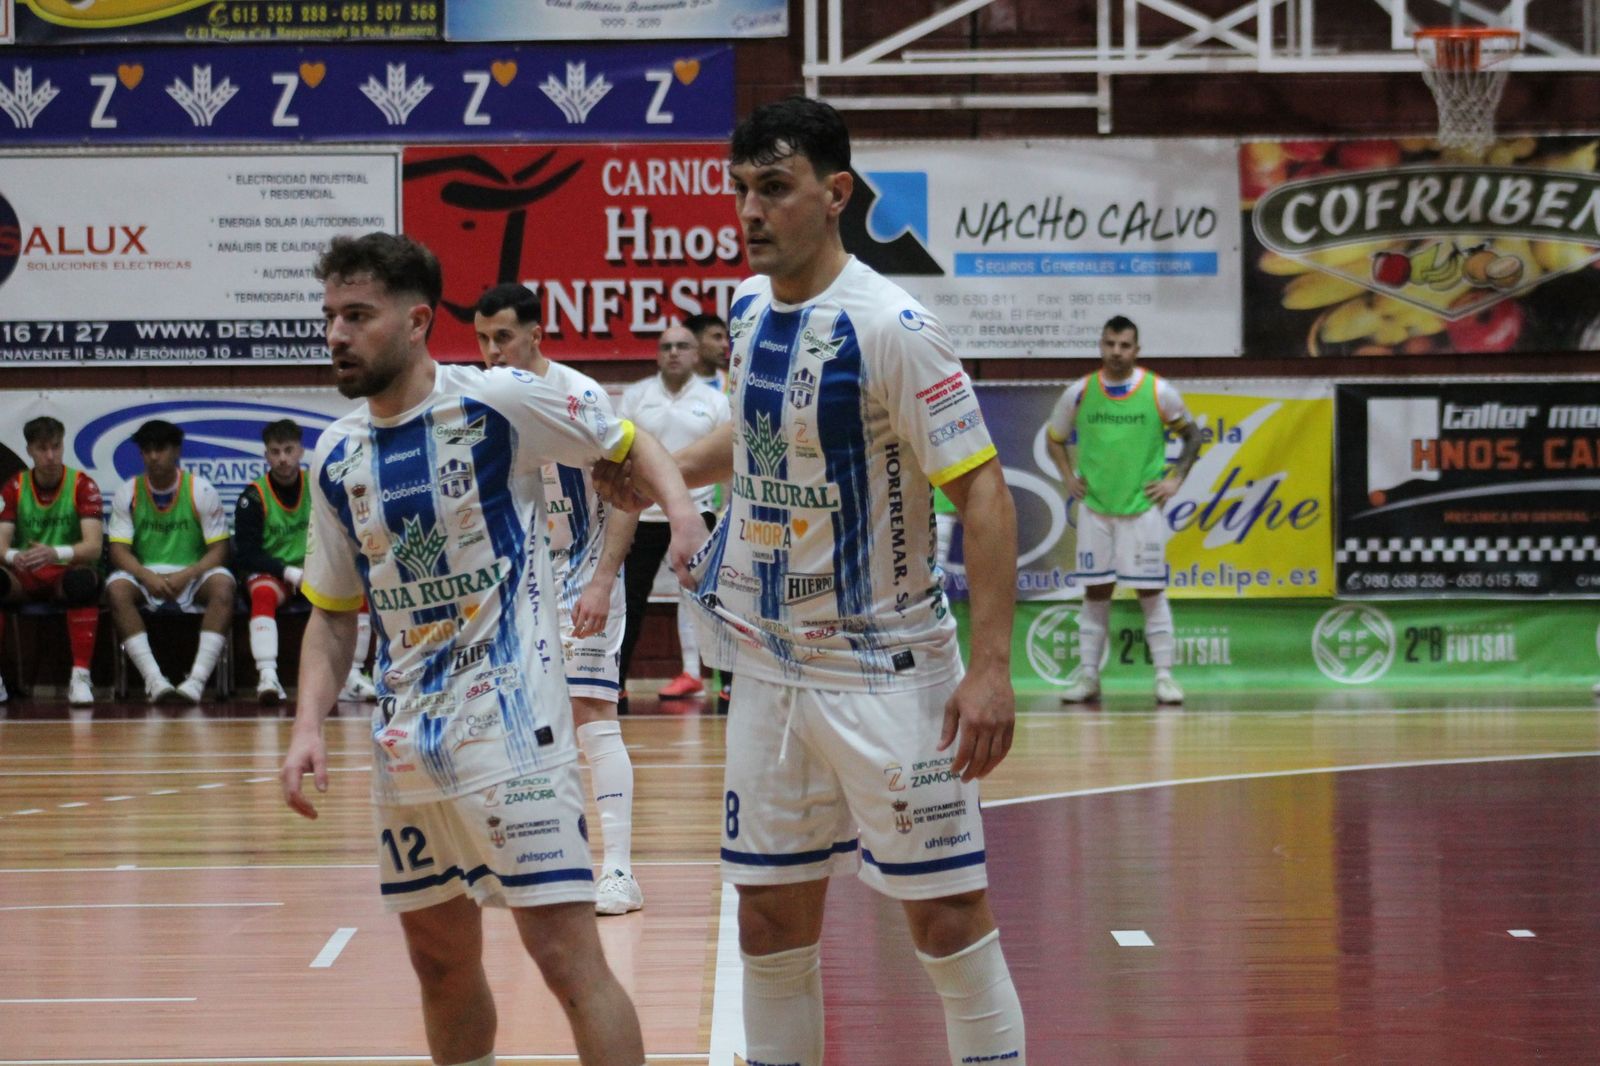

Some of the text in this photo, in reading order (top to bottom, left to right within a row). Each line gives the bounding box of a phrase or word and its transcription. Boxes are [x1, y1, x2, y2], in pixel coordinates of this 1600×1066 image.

[231, 5, 258, 23] 615
[236, 173, 369, 185] ELECTRICIDAD INDUSTRIAL
[260, 189, 335, 200] Y RESIDENCIAL
[264, 216, 298, 228] SOLAR
[956, 195, 1218, 246] NACHO CALVO
[604, 206, 739, 261] Hnos
[265, 242, 278, 252] DE
[27, 260, 192, 272] SOLUCIONES ELECTRICAS
[521, 279, 742, 334] NFEST
[3, 323, 32, 343] 16
[36, 323, 65, 343] 71
[75, 323, 109, 343] 27
[978, 325, 1060, 336] BENAVENTE
[0, 349, 71, 361] NAVENTE
[95, 348, 127, 360] SAN
[212, 347, 231, 360] 10
[1086, 412, 1146, 426] uhlsport
[1443, 402, 1539, 430] taller
[1543, 438, 1600, 470] CA
[761, 480, 839, 509] RURAL
[1165, 466, 1320, 545] elipe
[419, 562, 508, 606] RURAL
[1363, 573, 1389, 588] 980
[1456, 573, 1482, 588] 630
[1172, 636, 1232, 666] UTSAL
[504, 788, 557, 806] ZAMORA
[725, 790, 740, 840] 8
[912, 800, 966, 815] AYUNTAMIENTO
[926, 809, 967, 823] BENAVENTE
[506, 818, 561, 831] AYUNTAMIENTO
[924, 831, 972, 849] uhlsport
[381, 825, 435, 874] 12
[516, 849, 564, 864] uhlsport
